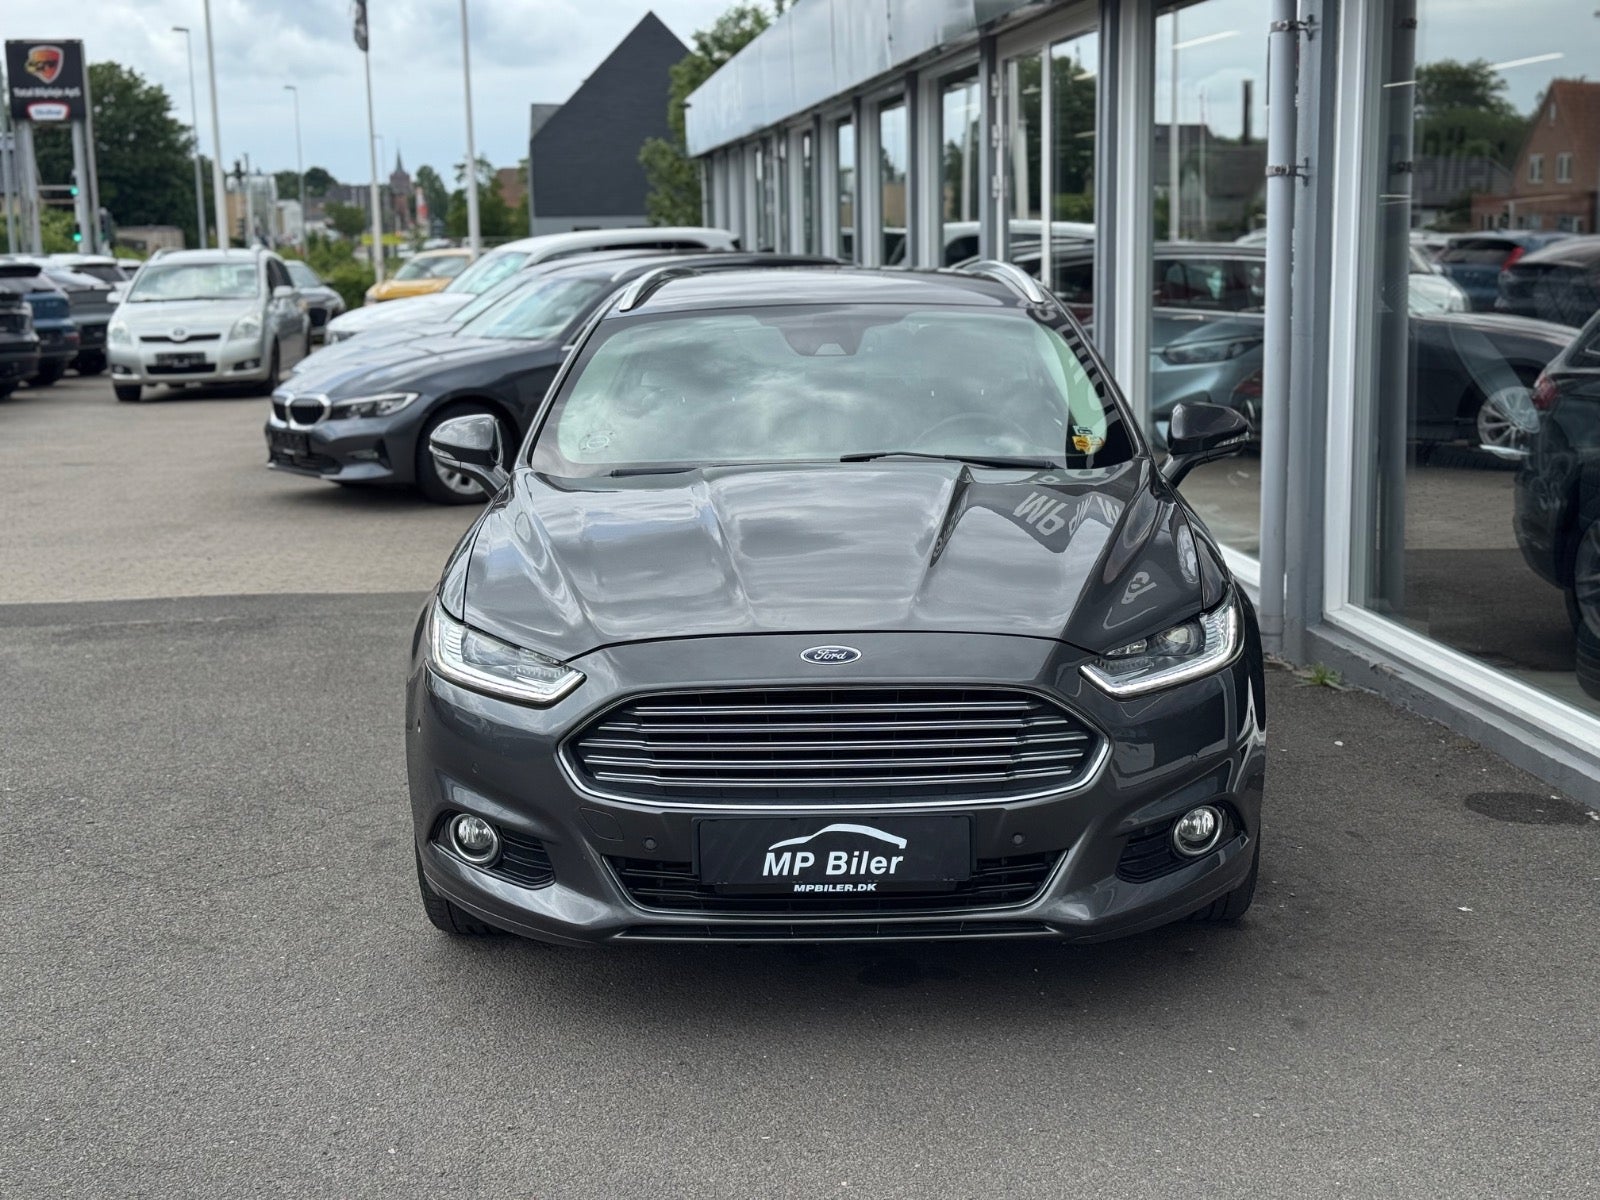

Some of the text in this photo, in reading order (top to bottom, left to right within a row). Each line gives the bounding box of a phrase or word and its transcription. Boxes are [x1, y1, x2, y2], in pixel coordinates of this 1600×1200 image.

[814, 649, 848, 660] Ford
[762, 850, 904, 877] MP Biler
[793, 882, 877, 893] MPBILER.DK
